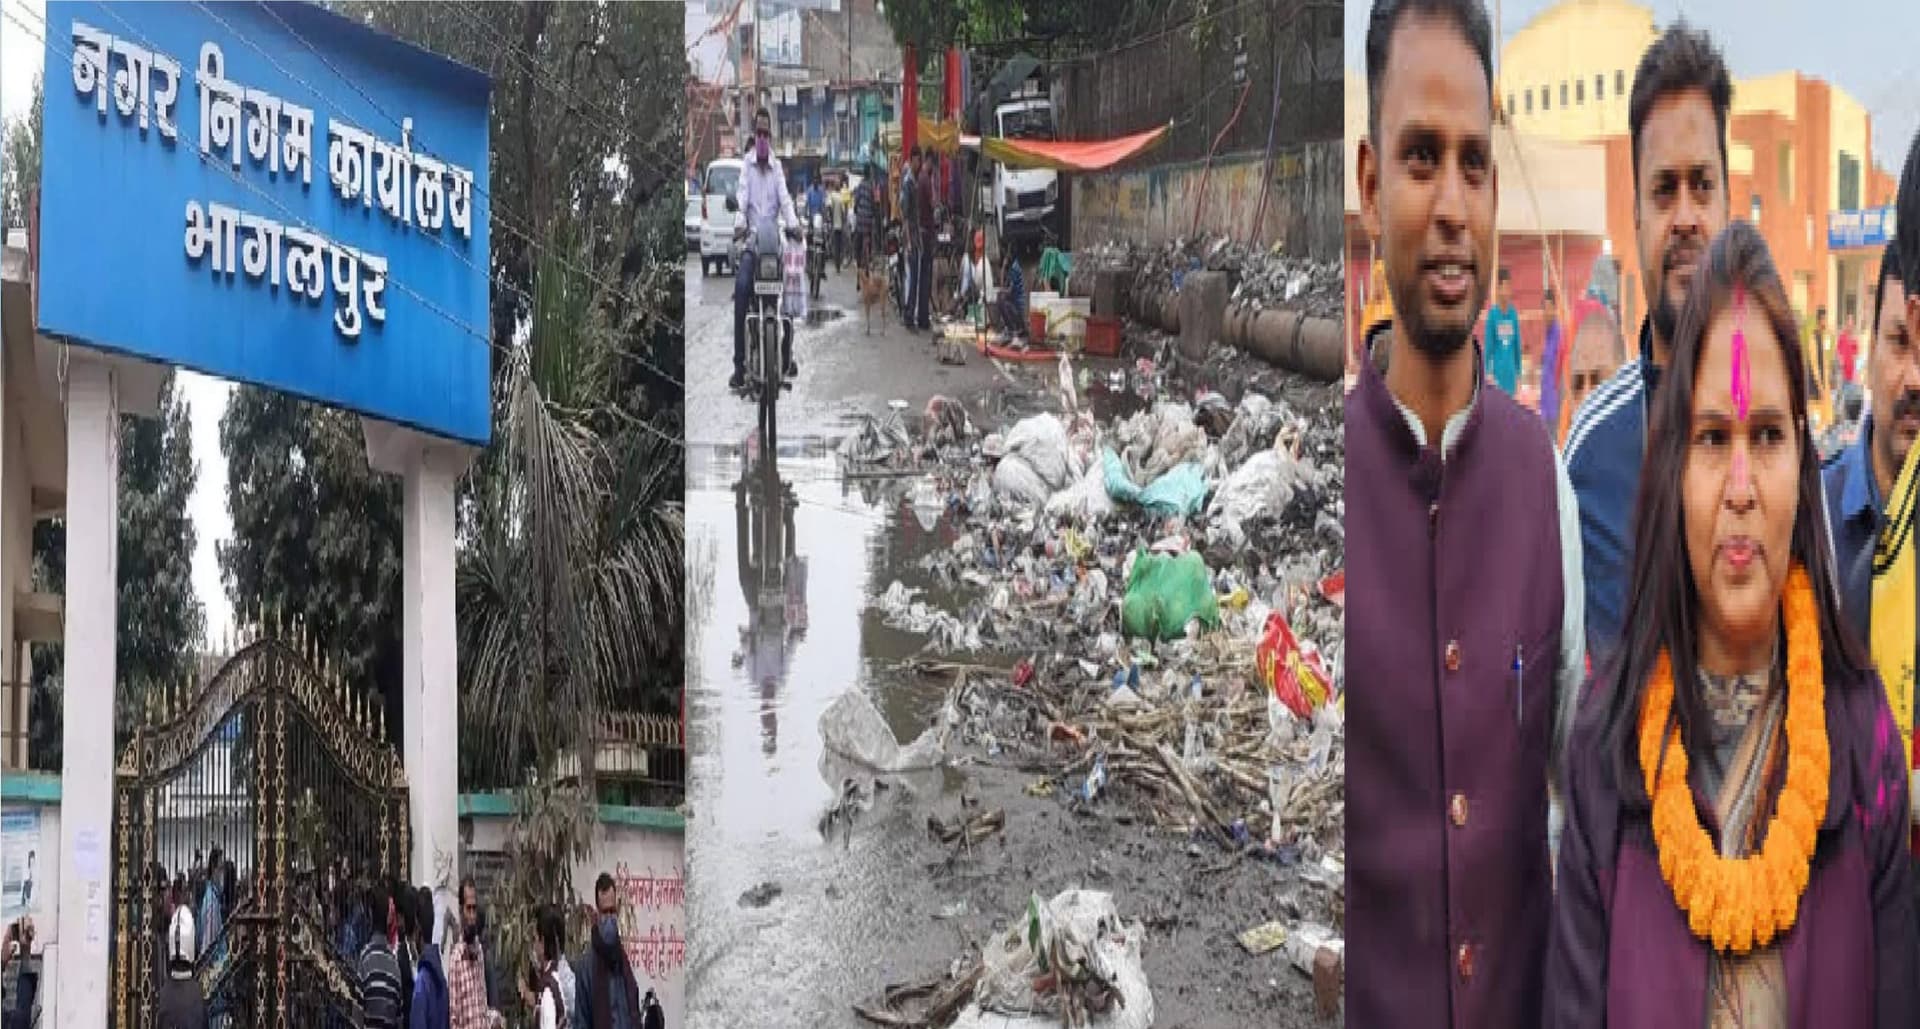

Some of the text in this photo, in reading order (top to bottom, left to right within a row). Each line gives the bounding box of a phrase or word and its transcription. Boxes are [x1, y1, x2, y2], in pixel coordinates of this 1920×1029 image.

[72, 21, 474, 241] नगर निगम कार्यालय
[185, 200, 389, 338] भागलपुर
